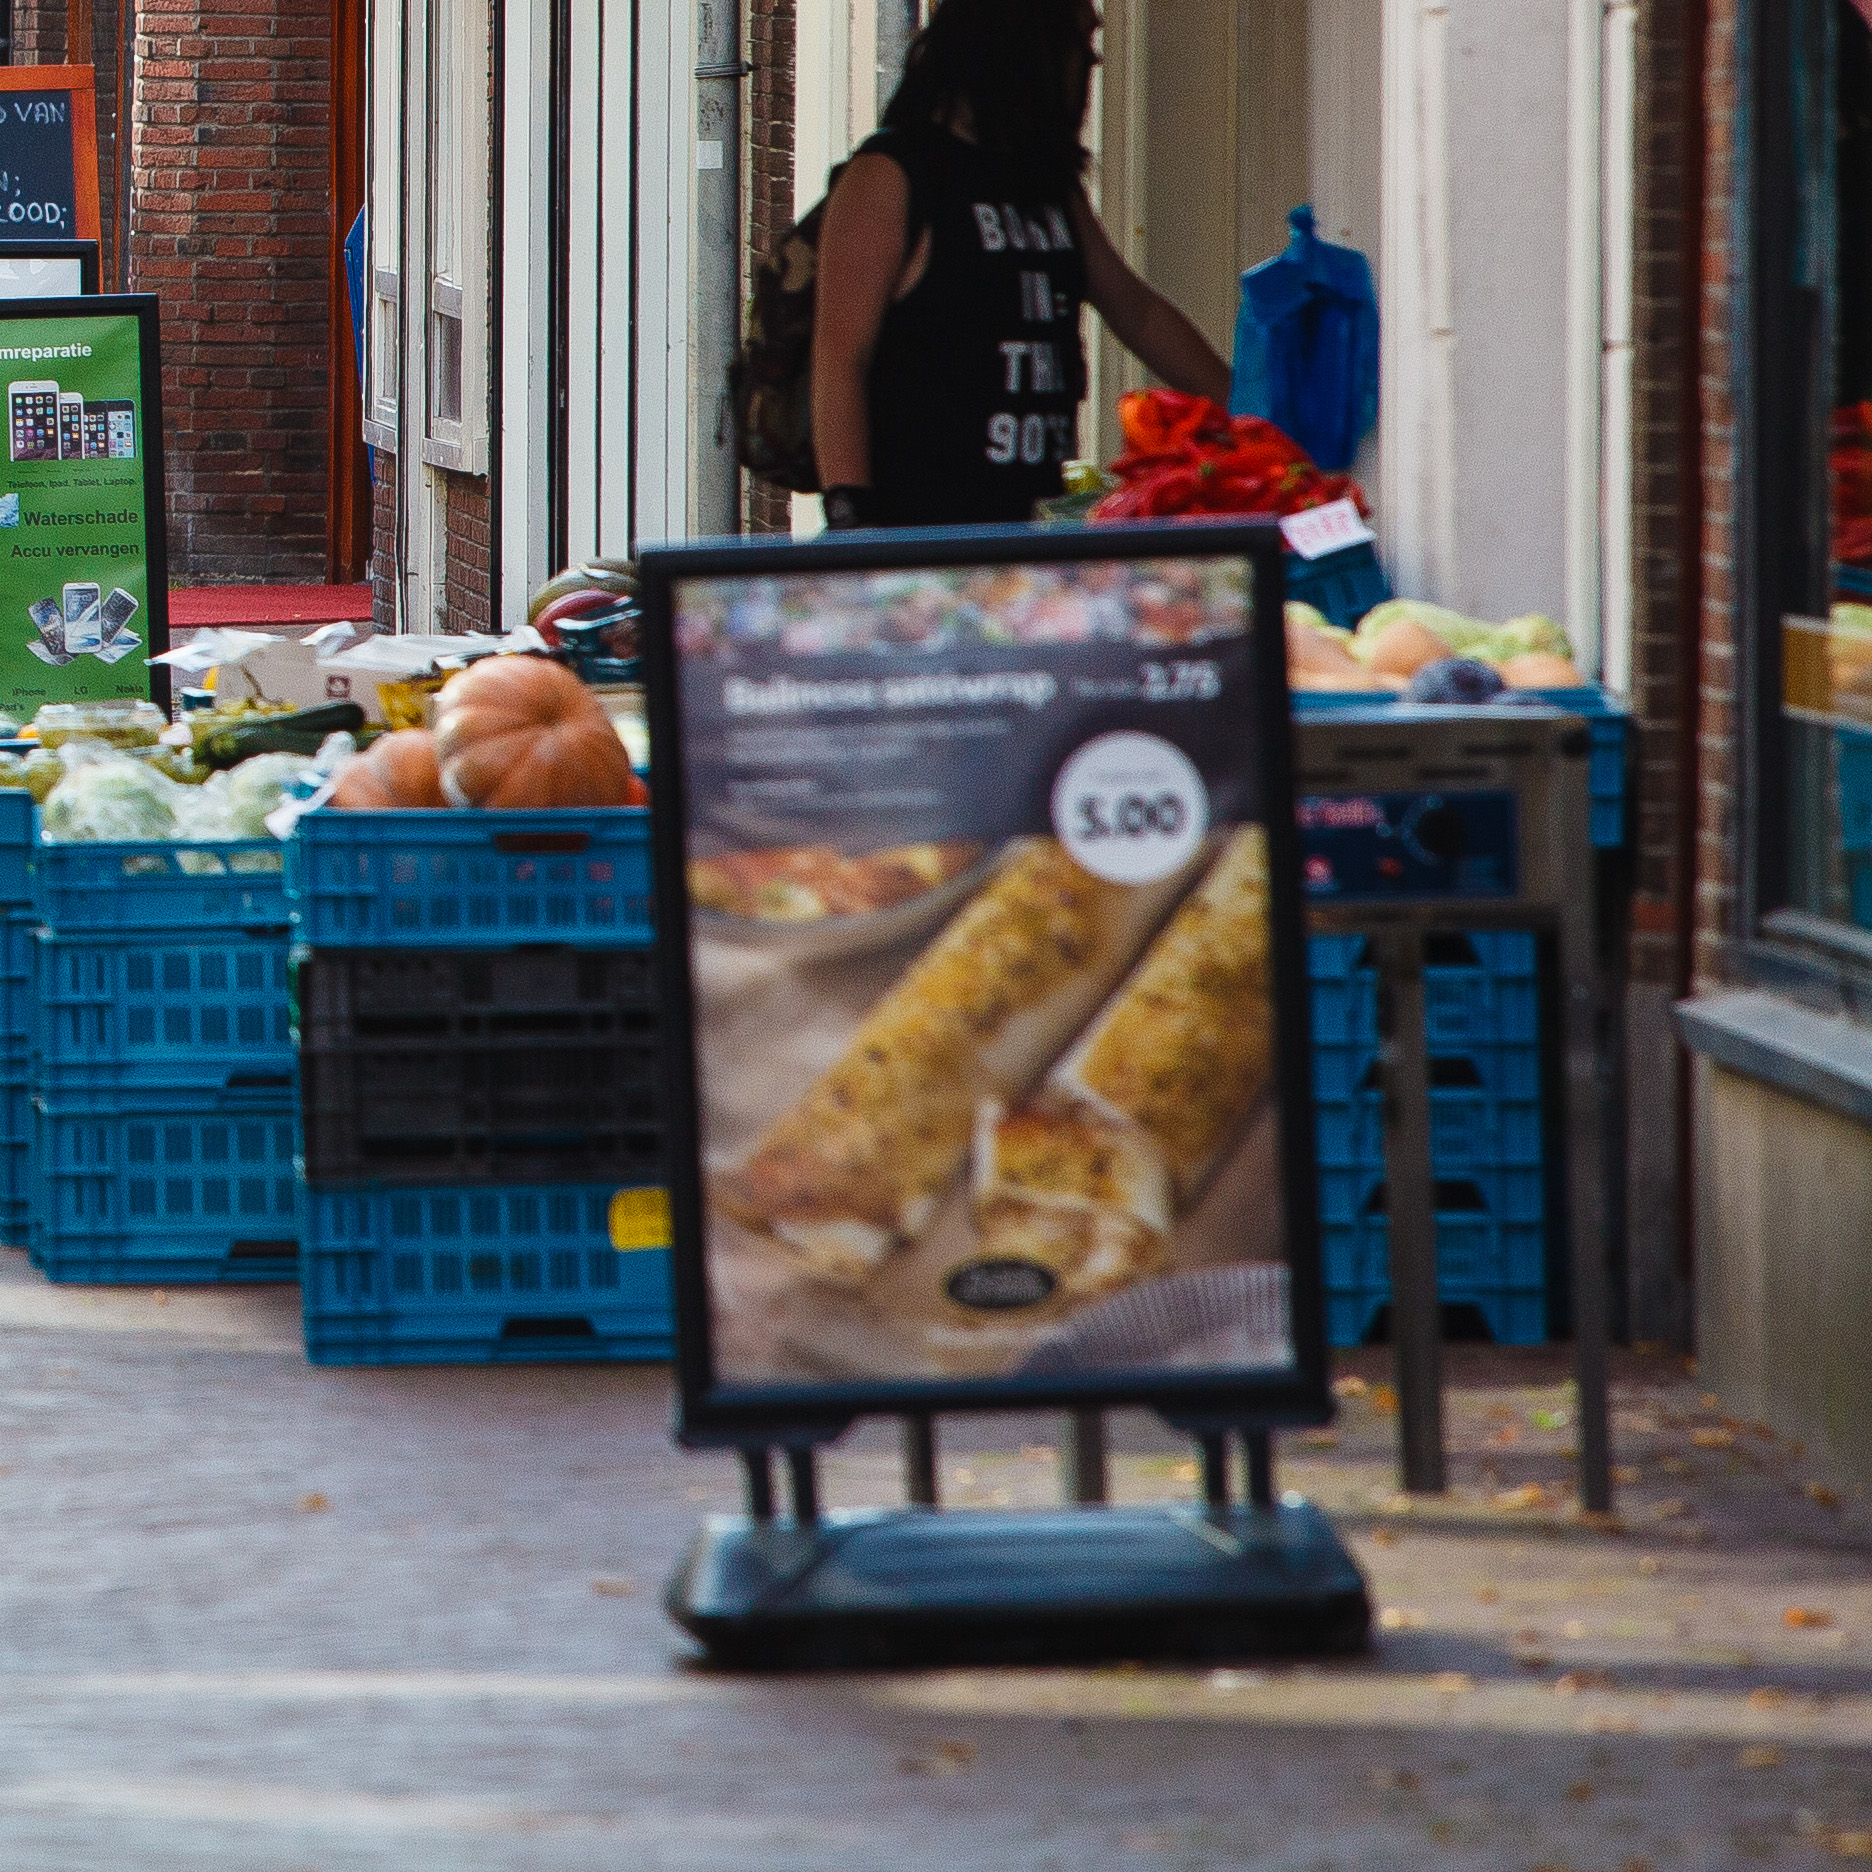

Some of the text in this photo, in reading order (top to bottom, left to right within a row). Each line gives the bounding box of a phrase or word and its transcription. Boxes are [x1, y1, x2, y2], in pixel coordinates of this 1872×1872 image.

[14, 101, 66, 125] VAN
[22, 508, 139, 527] Waterschade
[11, 543, 140, 559] Accu vervangen
